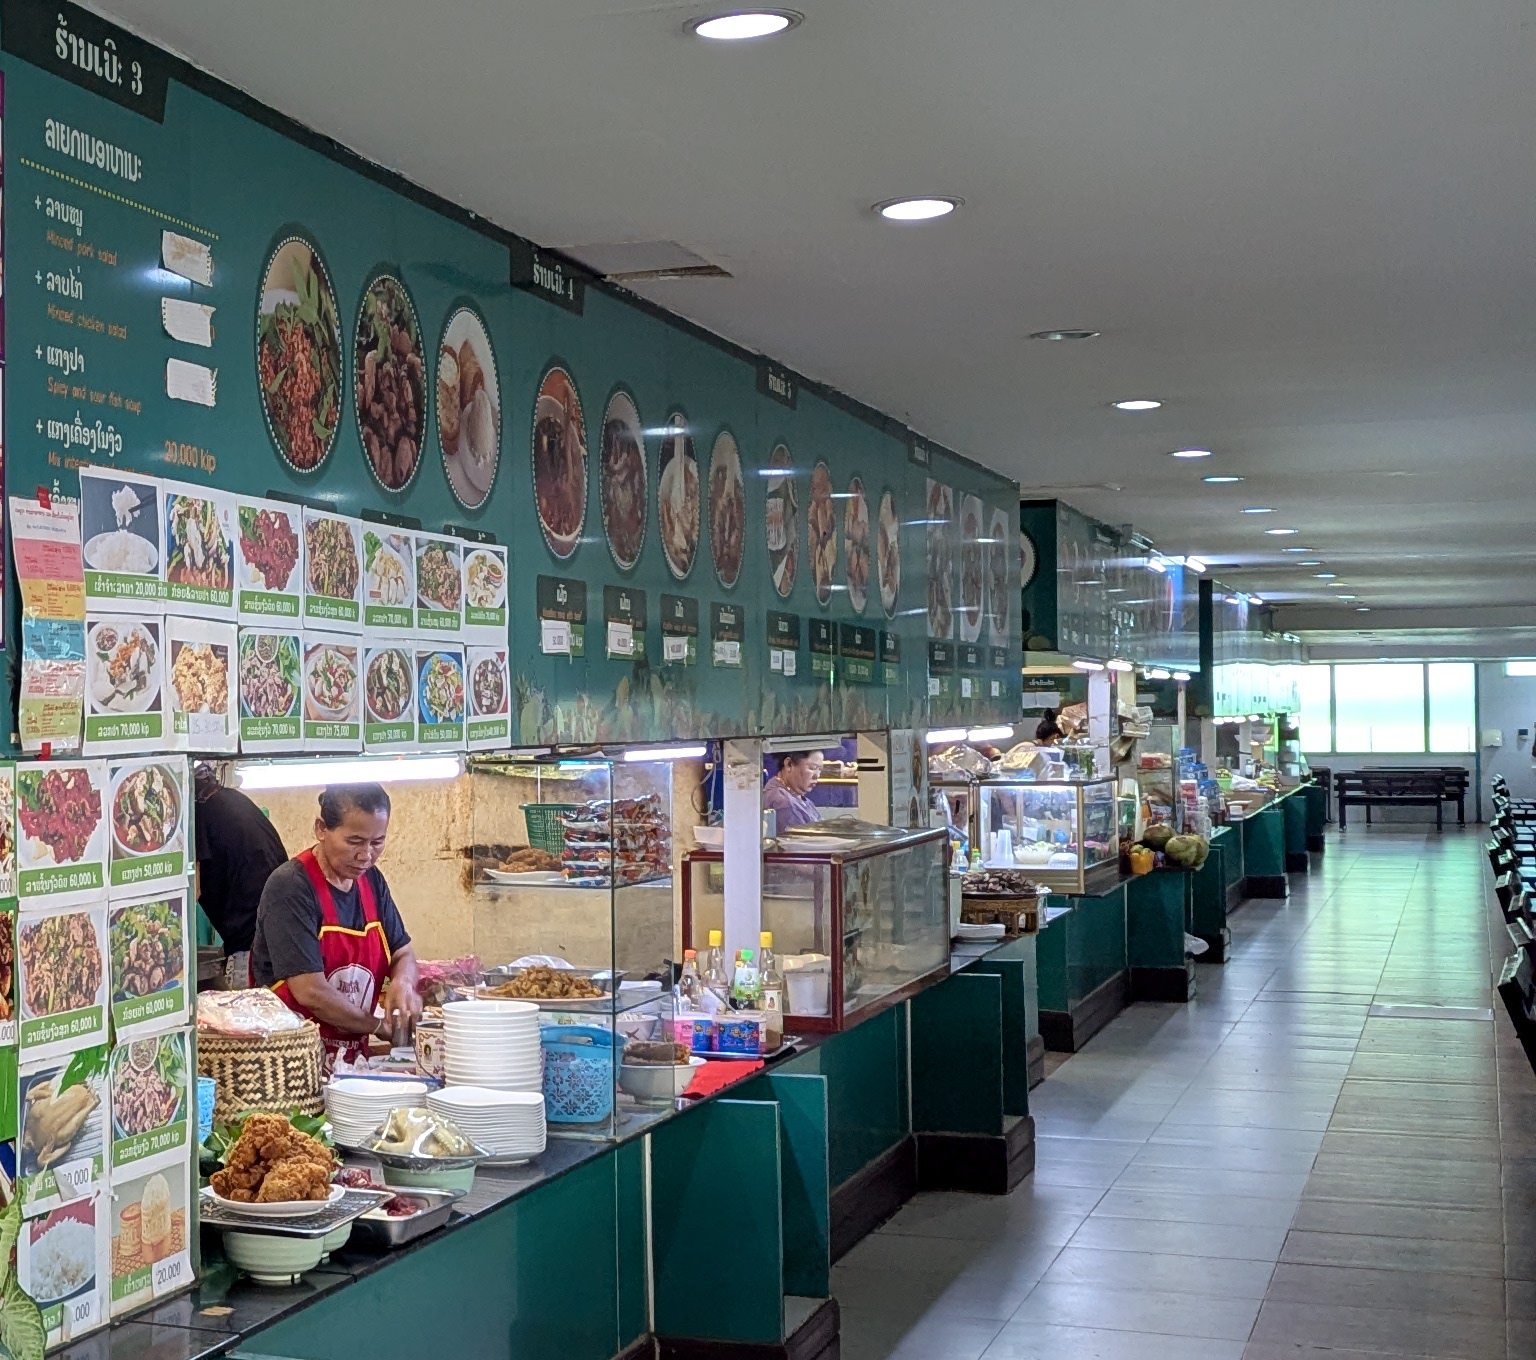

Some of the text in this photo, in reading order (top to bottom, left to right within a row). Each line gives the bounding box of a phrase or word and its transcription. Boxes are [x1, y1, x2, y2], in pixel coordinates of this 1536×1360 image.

[131, 61, 143, 95] 3
[200, 448, 216, 475] kip
[135, 581, 157, 599] 20,000
[120, 723, 140, 738] 70,000
[69, 871, 92, 888] 60,000
[143, 865, 163, 881] 50,000
[145, 998, 164, 1016] 60,000
[71, 1018, 92, 1036] 60,000
[150, 1132, 170, 1151] 70,000
